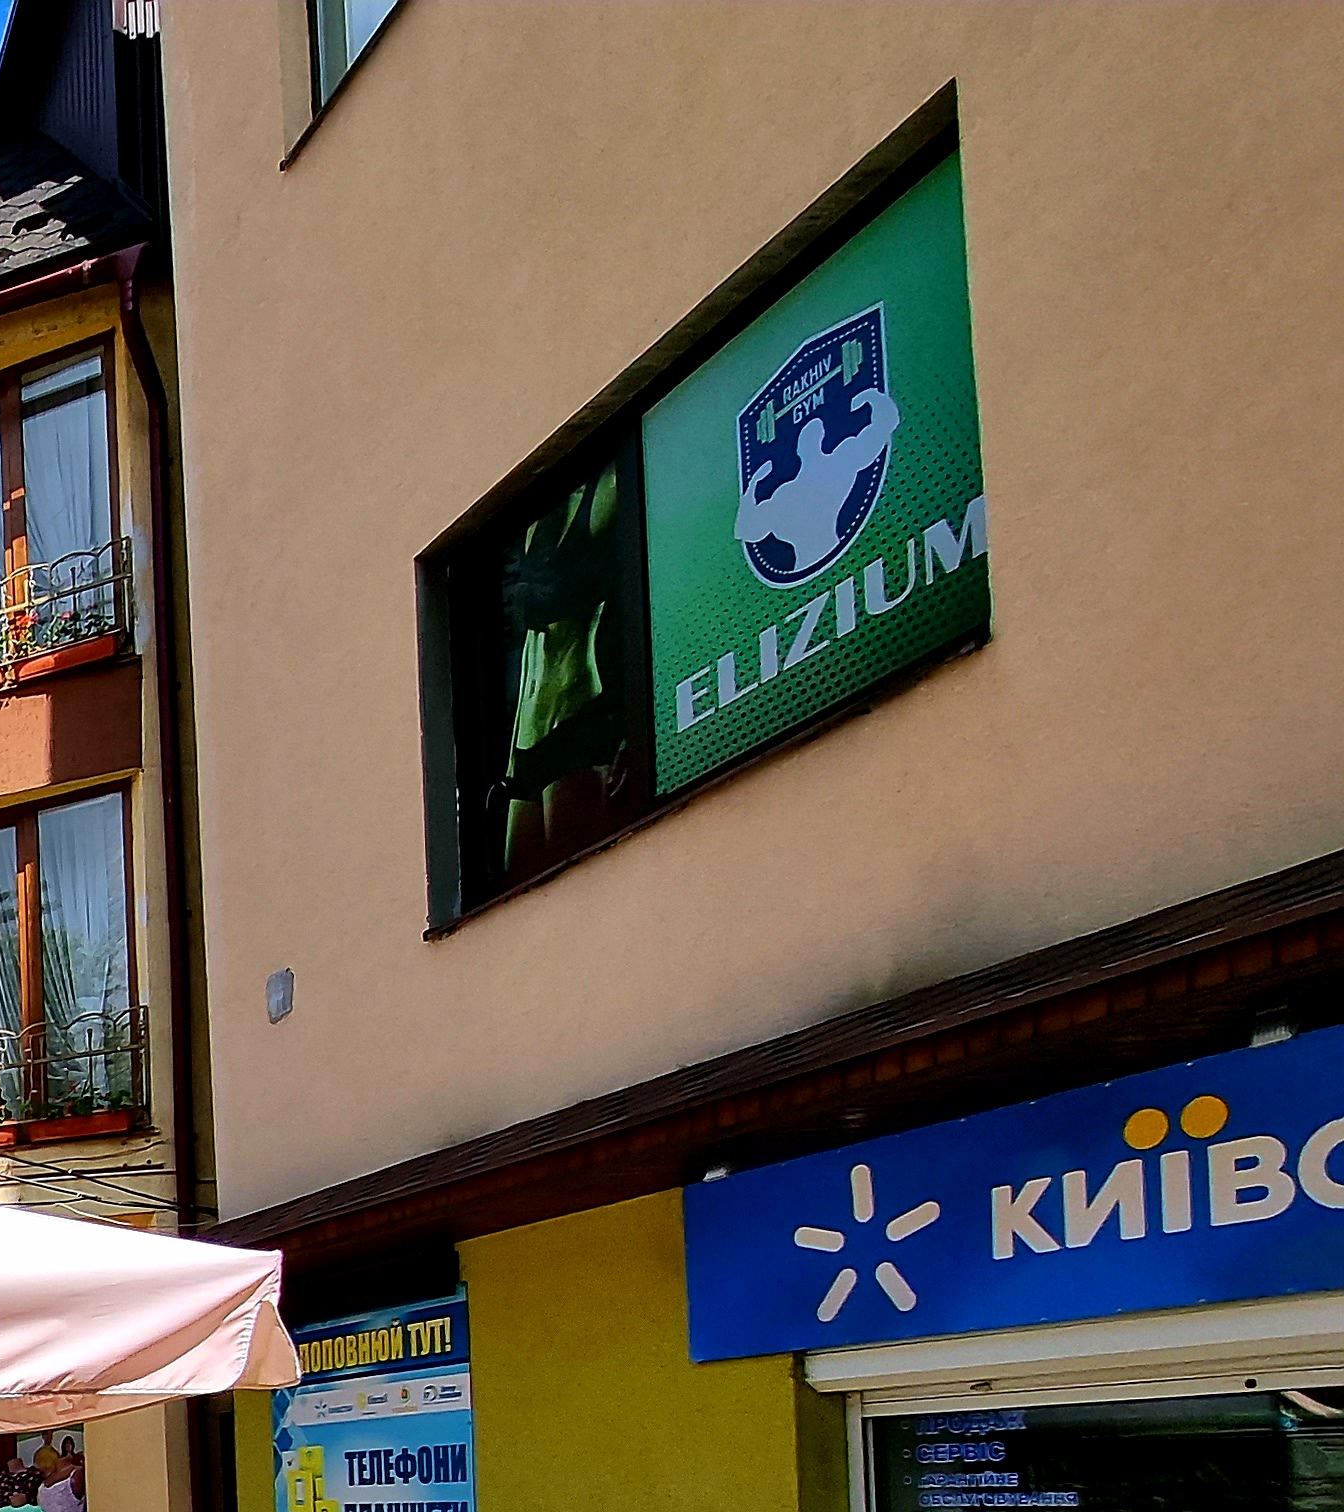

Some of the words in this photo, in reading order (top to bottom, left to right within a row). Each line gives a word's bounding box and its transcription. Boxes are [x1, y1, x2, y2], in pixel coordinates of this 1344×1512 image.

[782, 353, 833, 405] RAKHIV
[793, 386, 825, 425] GYM
[676, 494, 989, 733] ELIZIUM
[298, 1318, 404, 1373] ПОПОВНЮЙ
[407, 1316, 451, 1357] ТУТ!
[344, 1443, 468, 1487] ТЕЛЕФОНИ
[916, 1441, 1006, 1463] СЕРВІС
